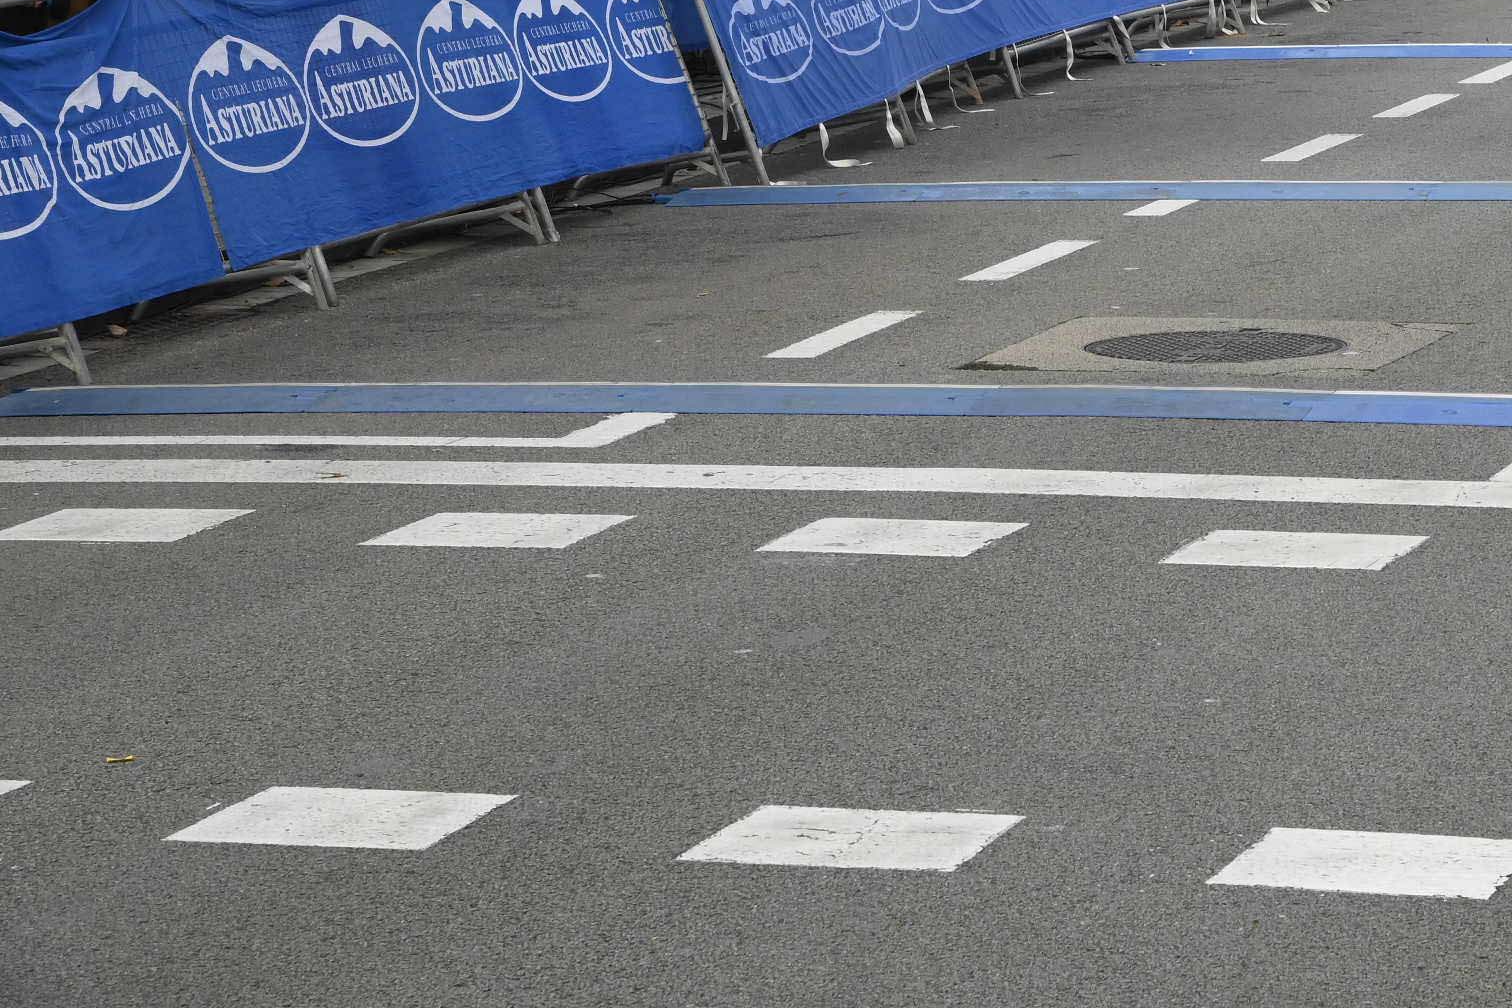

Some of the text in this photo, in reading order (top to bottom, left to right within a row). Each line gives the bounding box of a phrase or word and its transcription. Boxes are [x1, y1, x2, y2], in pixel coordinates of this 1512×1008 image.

[436, 37, 471, 54] CENTRAL
[522, 31, 608, 77] ASTURIANA
[615, 16, 678, 61] ASTUR
[211, 76, 288, 100] CENTRAL LECHERA
[324, 53, 400, 78] CENTRAL LECHERA
[427, 47, 519, 95] ASTURIANA
[314, 70, 415, 120] ASTURIANA
[201, 93, 305, 146] ASTURIANA
